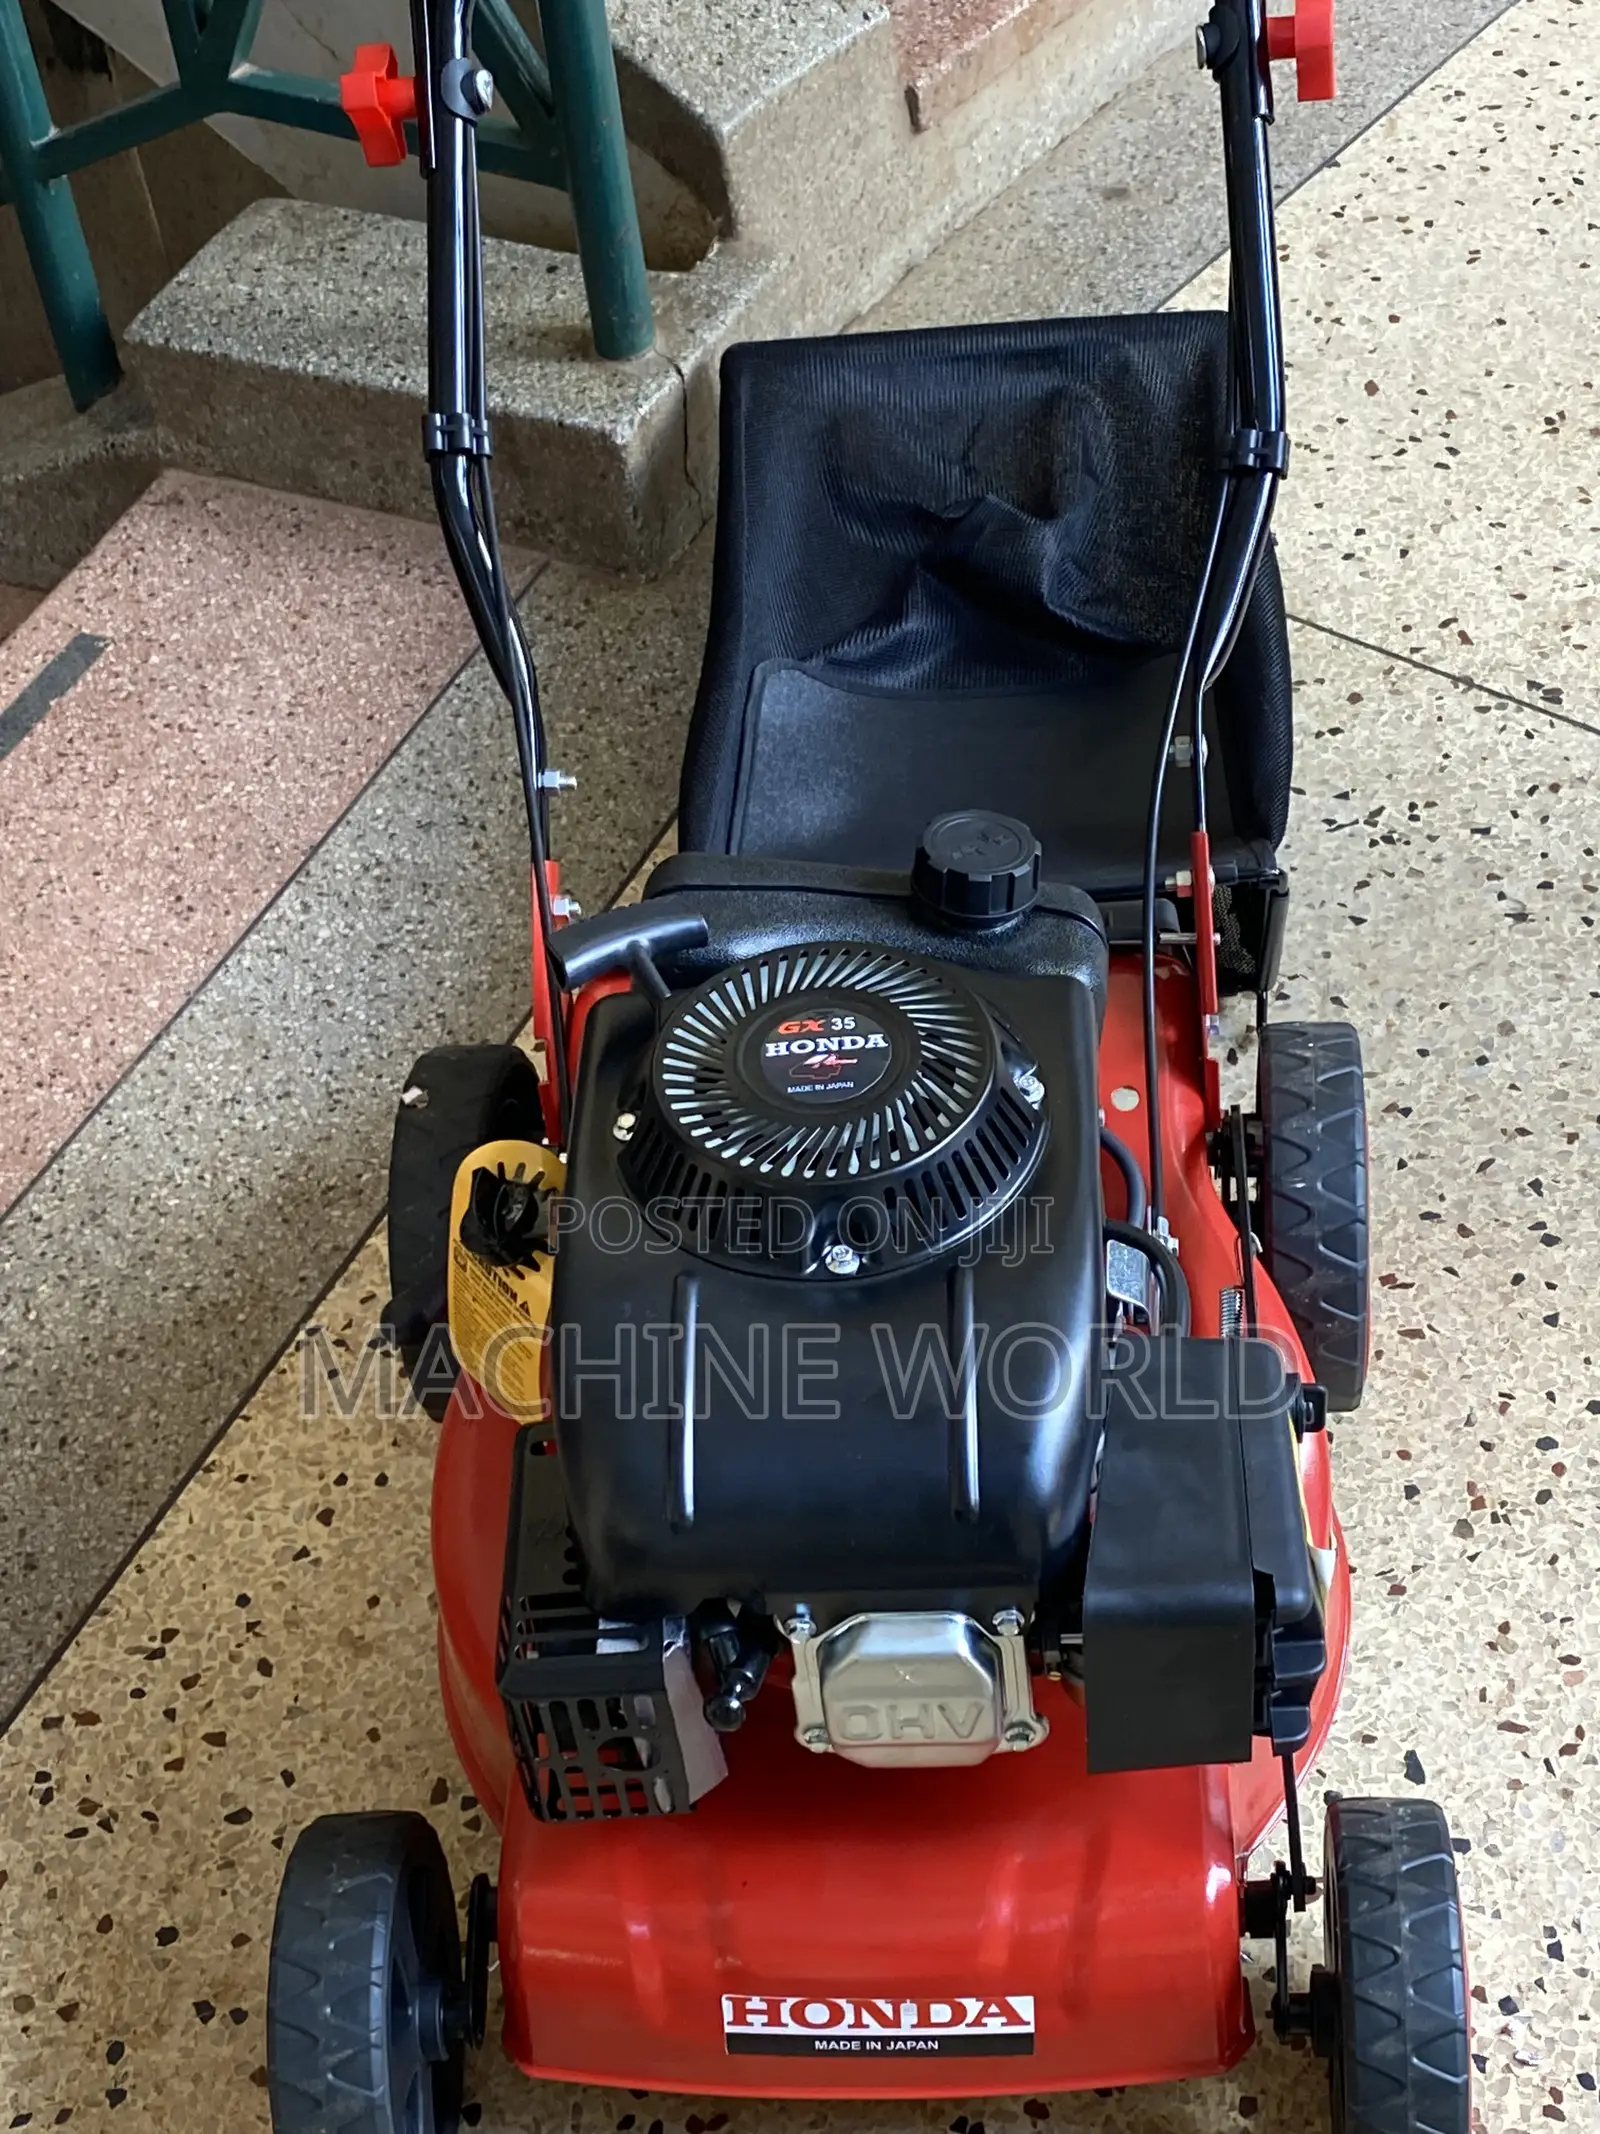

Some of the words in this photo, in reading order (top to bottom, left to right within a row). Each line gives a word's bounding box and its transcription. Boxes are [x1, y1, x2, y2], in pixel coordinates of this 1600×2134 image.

[778, 1019, 826, 1035] GX
[831, 1017, 856, 1031] 35
[765, 1033, 888, 1057] HONDA
[787, 1084, 813, 1094] MADE
[826, 1081, 854, 1090] JAPAN
[837, 1701, 985, 1740] OHV
[725, 1996, 1031, 2030] HONDA
[814, 2040, 861, 2050] MADE
[866, 2040, 882, 2050] IN
[886, 2040, 939, 2050] JAPAN
